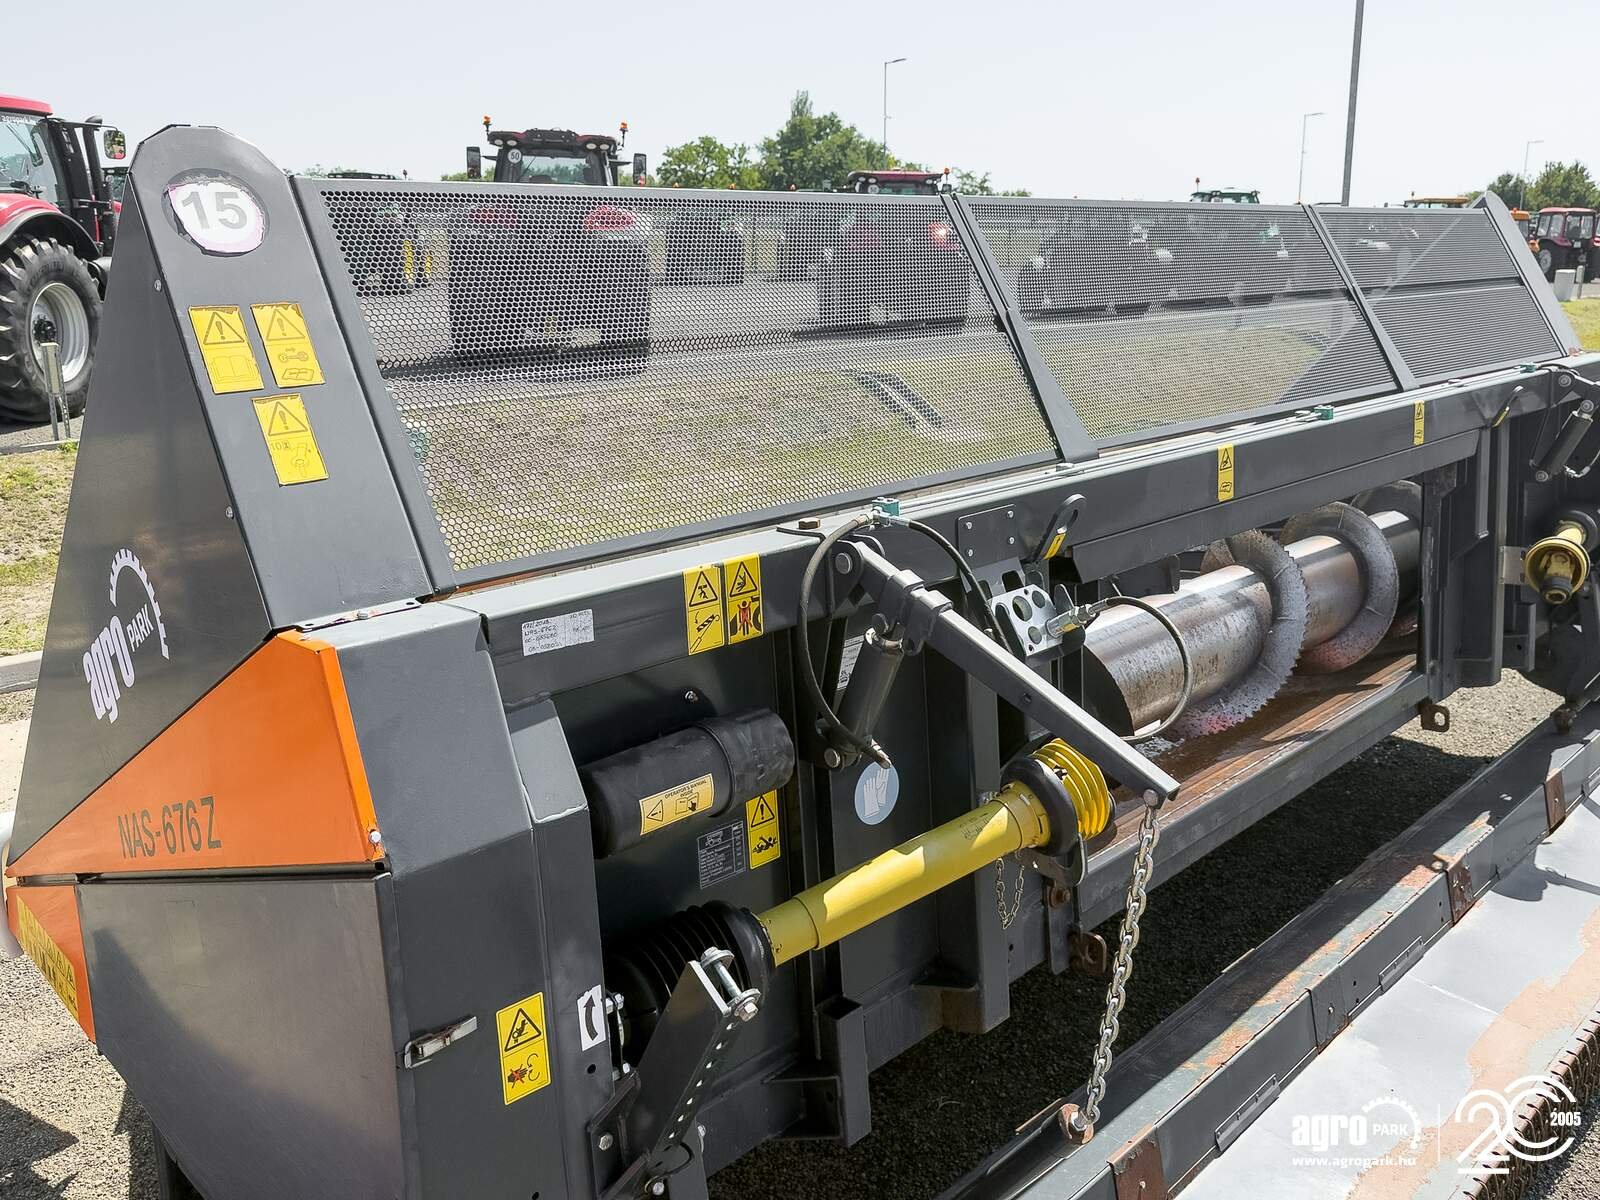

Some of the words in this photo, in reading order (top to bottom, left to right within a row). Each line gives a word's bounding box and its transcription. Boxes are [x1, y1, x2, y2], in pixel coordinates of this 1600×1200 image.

[510, 152, 520, 160] 50
[181, 191, 248, 230] 15
[82, 615, 135, 724] agro
[126, 603, 154, 653] PARK
